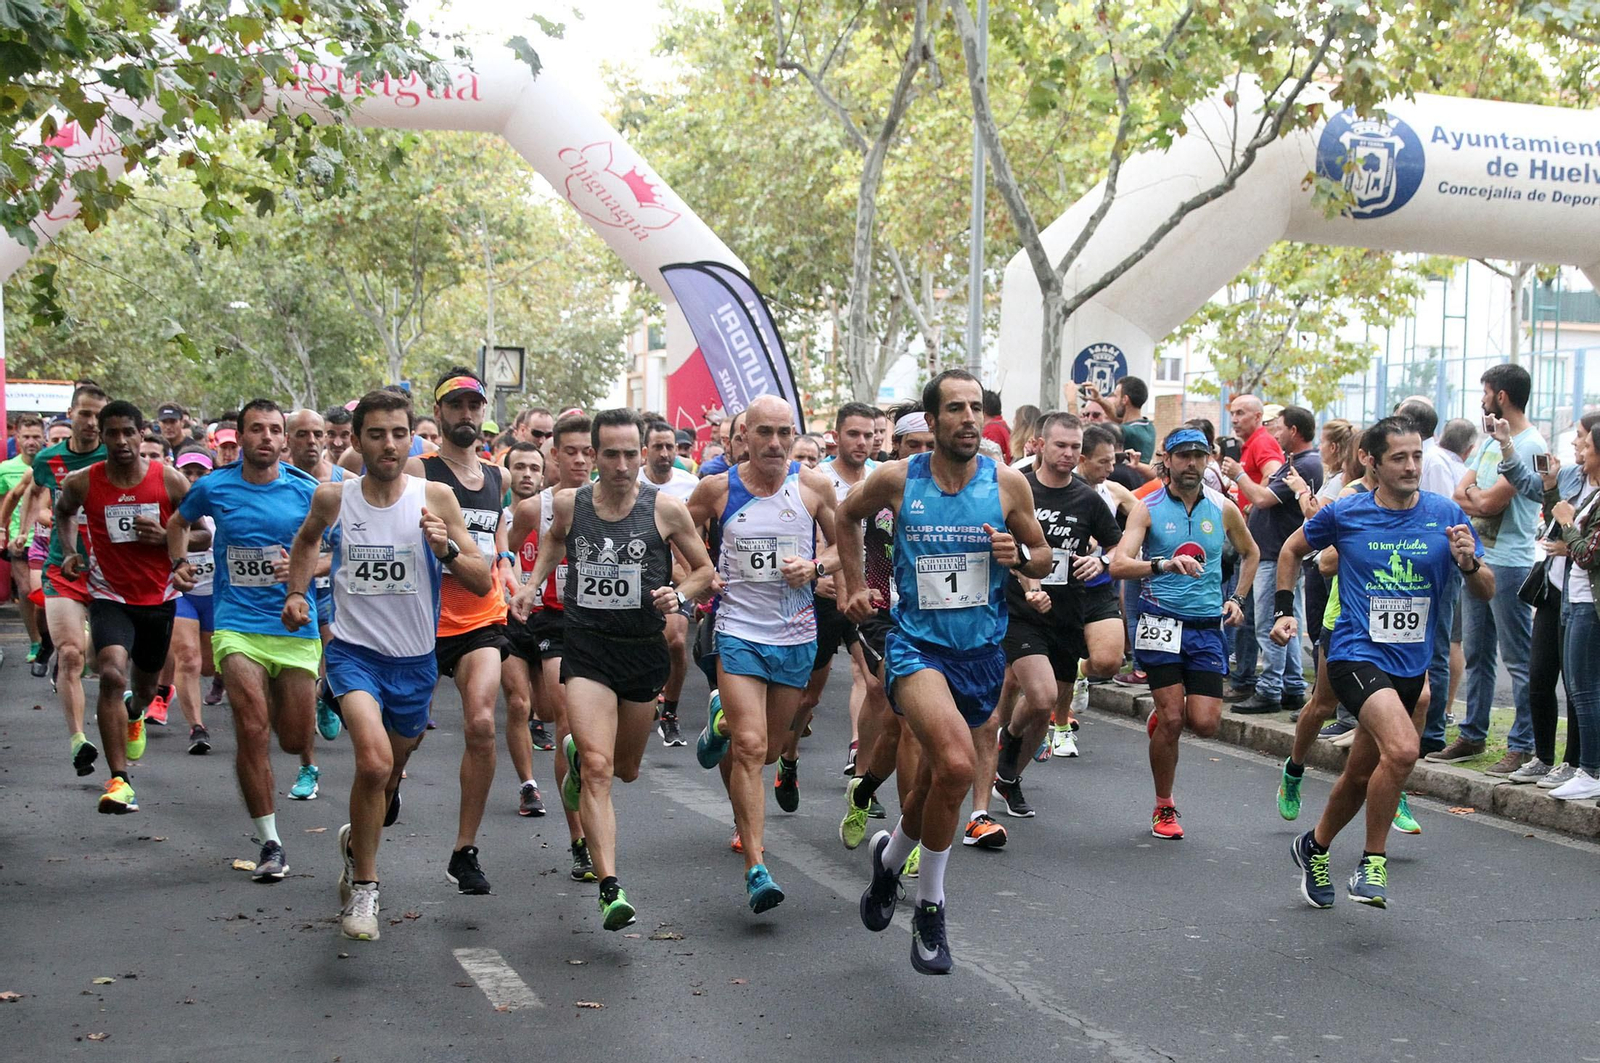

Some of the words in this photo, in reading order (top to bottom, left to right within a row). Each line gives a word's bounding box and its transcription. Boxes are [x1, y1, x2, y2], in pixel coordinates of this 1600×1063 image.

[1486, 156, 1519, 178] de
[558, 148, 649, 241] Chiguagua
[1527, 189, 1546, 201] de
[1552, 191, 1600, 207] Depor
[118, 517, 137, 531] 6
[905, 525, 934, 533] CLUB
[935, 525, 998, 533] ONUBEN
[1047, 524, 1072, 536] TUR
[906, 534, 920, 542] DE
[1061, 537, 1080, 549] NA
[1368, 542, 1379, 550] 10
[1380, 542, 1394, 550] km
[1396, 539, 1428, 550] Huelva
[194, 562, 214, 575] 63
[234, 560, 275, 576] 386
[750, 551, 777, 570] 61
[927, 563, 958, 571] HUELVA
[355, 562, 406, 581] 450
[583, 577, 629, 597] 260
[945, 572, 957, 593] 1
[1378, 611, 1420, 630] 189
[1140, 625, 1173, 643] 293
